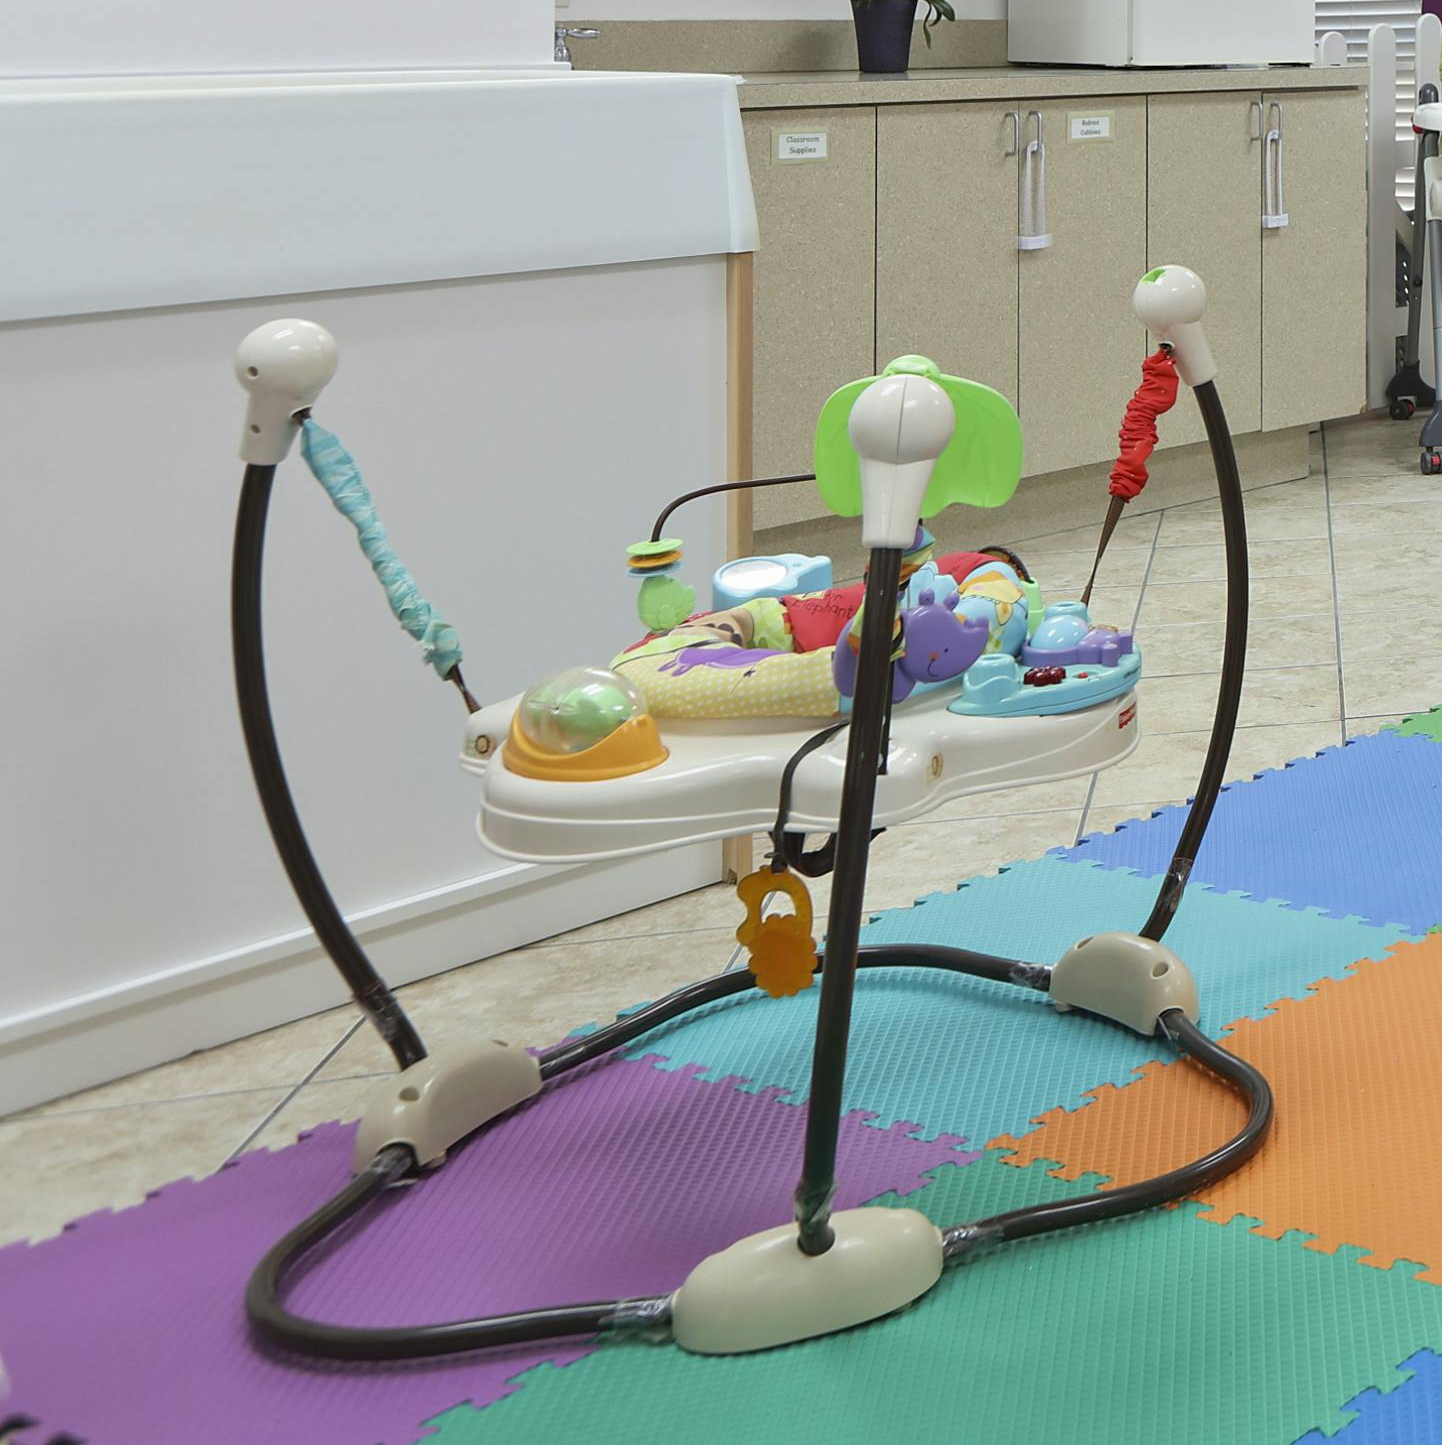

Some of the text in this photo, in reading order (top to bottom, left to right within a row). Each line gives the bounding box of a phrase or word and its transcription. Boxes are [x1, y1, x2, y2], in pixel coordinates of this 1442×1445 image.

[785, 135, 820, 143] Classroom
[788, 146, 817, 155] Supplies
[792, 599, 852, 619] Elephant
